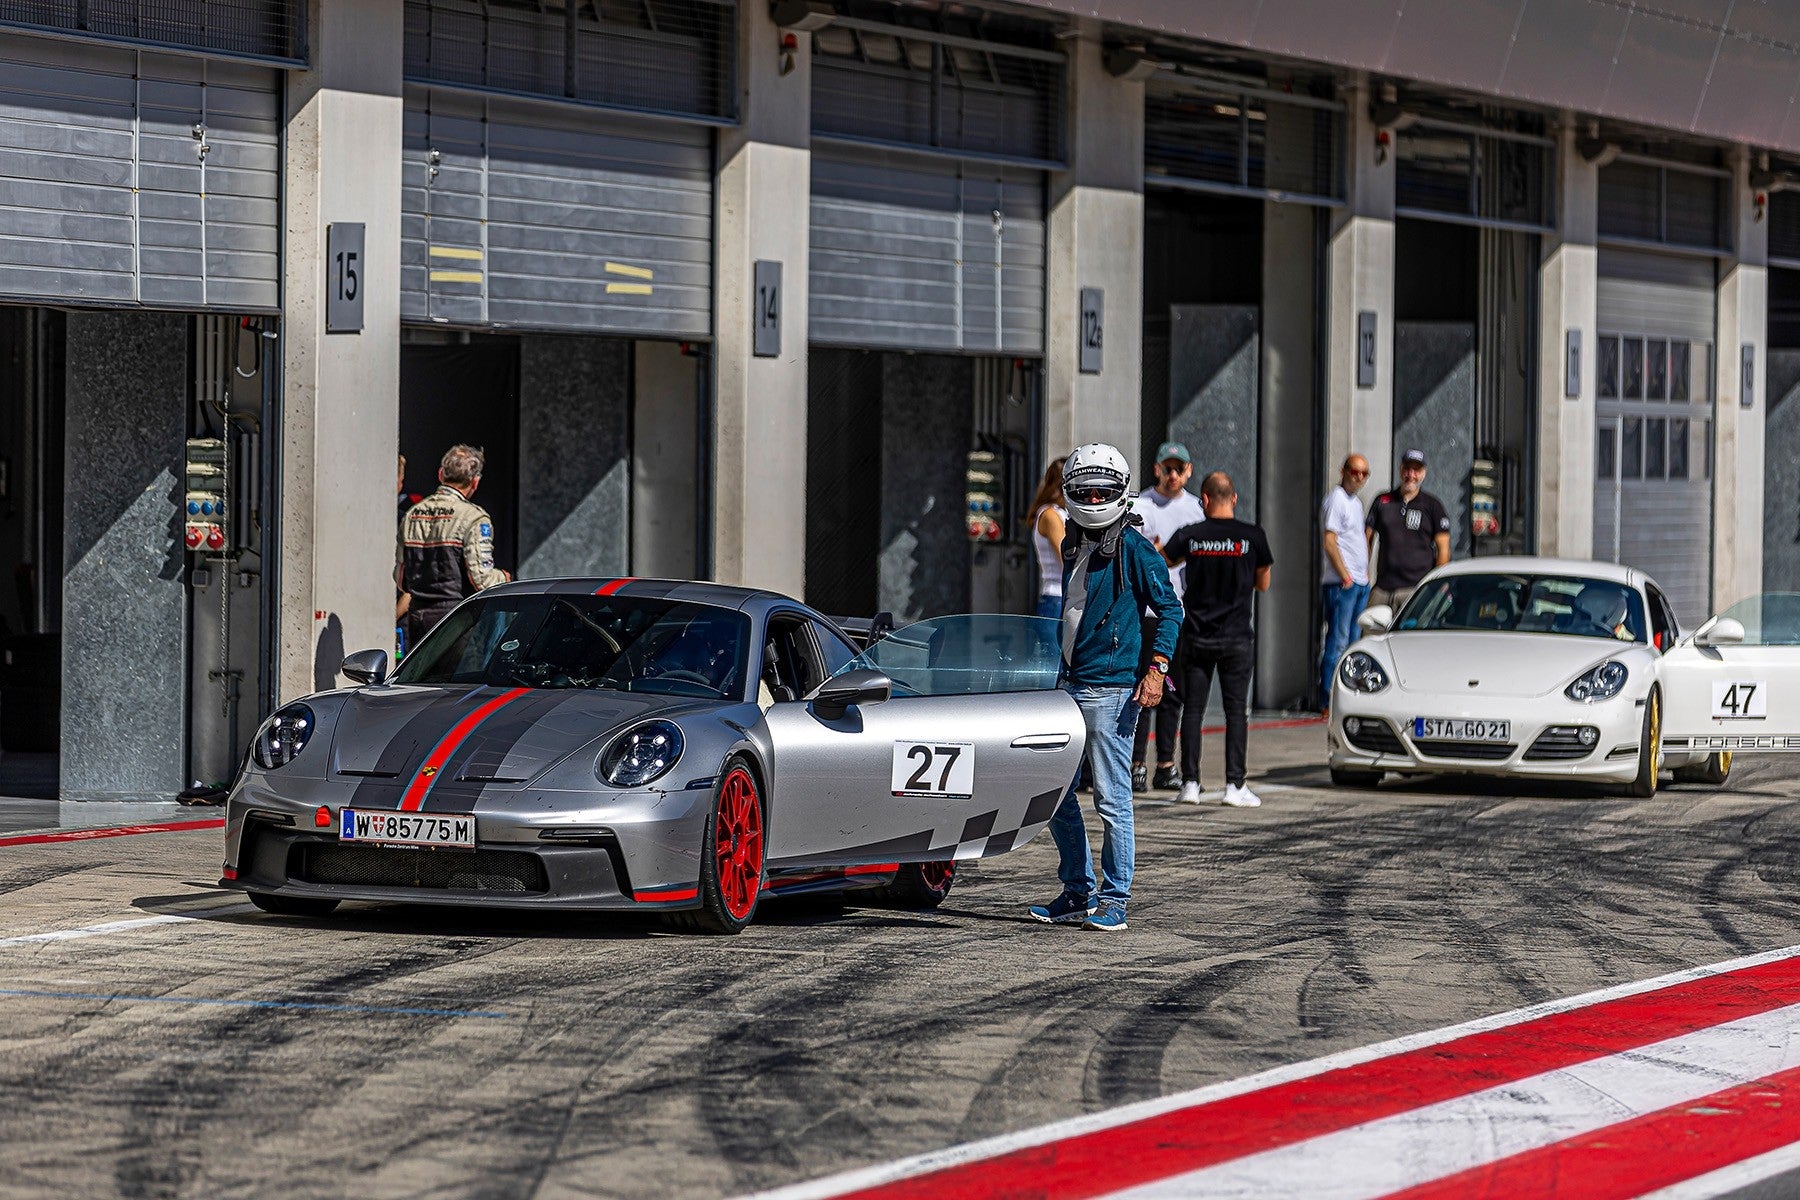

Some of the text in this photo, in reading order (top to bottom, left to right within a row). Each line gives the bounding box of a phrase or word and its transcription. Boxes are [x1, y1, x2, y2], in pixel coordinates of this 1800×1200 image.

[336, 251, 357, 301] 15
[760, 286, 777, 329] 14
[1721, 683, 1757, 714] 47
[1425, 720, 1454, 738] STA
[1489, 721, 1507, 739] 21
[904, 744, 962, 792] 27
[345, 827, 352, 835] A
[356, 814, 468, 842] W 85775 M
